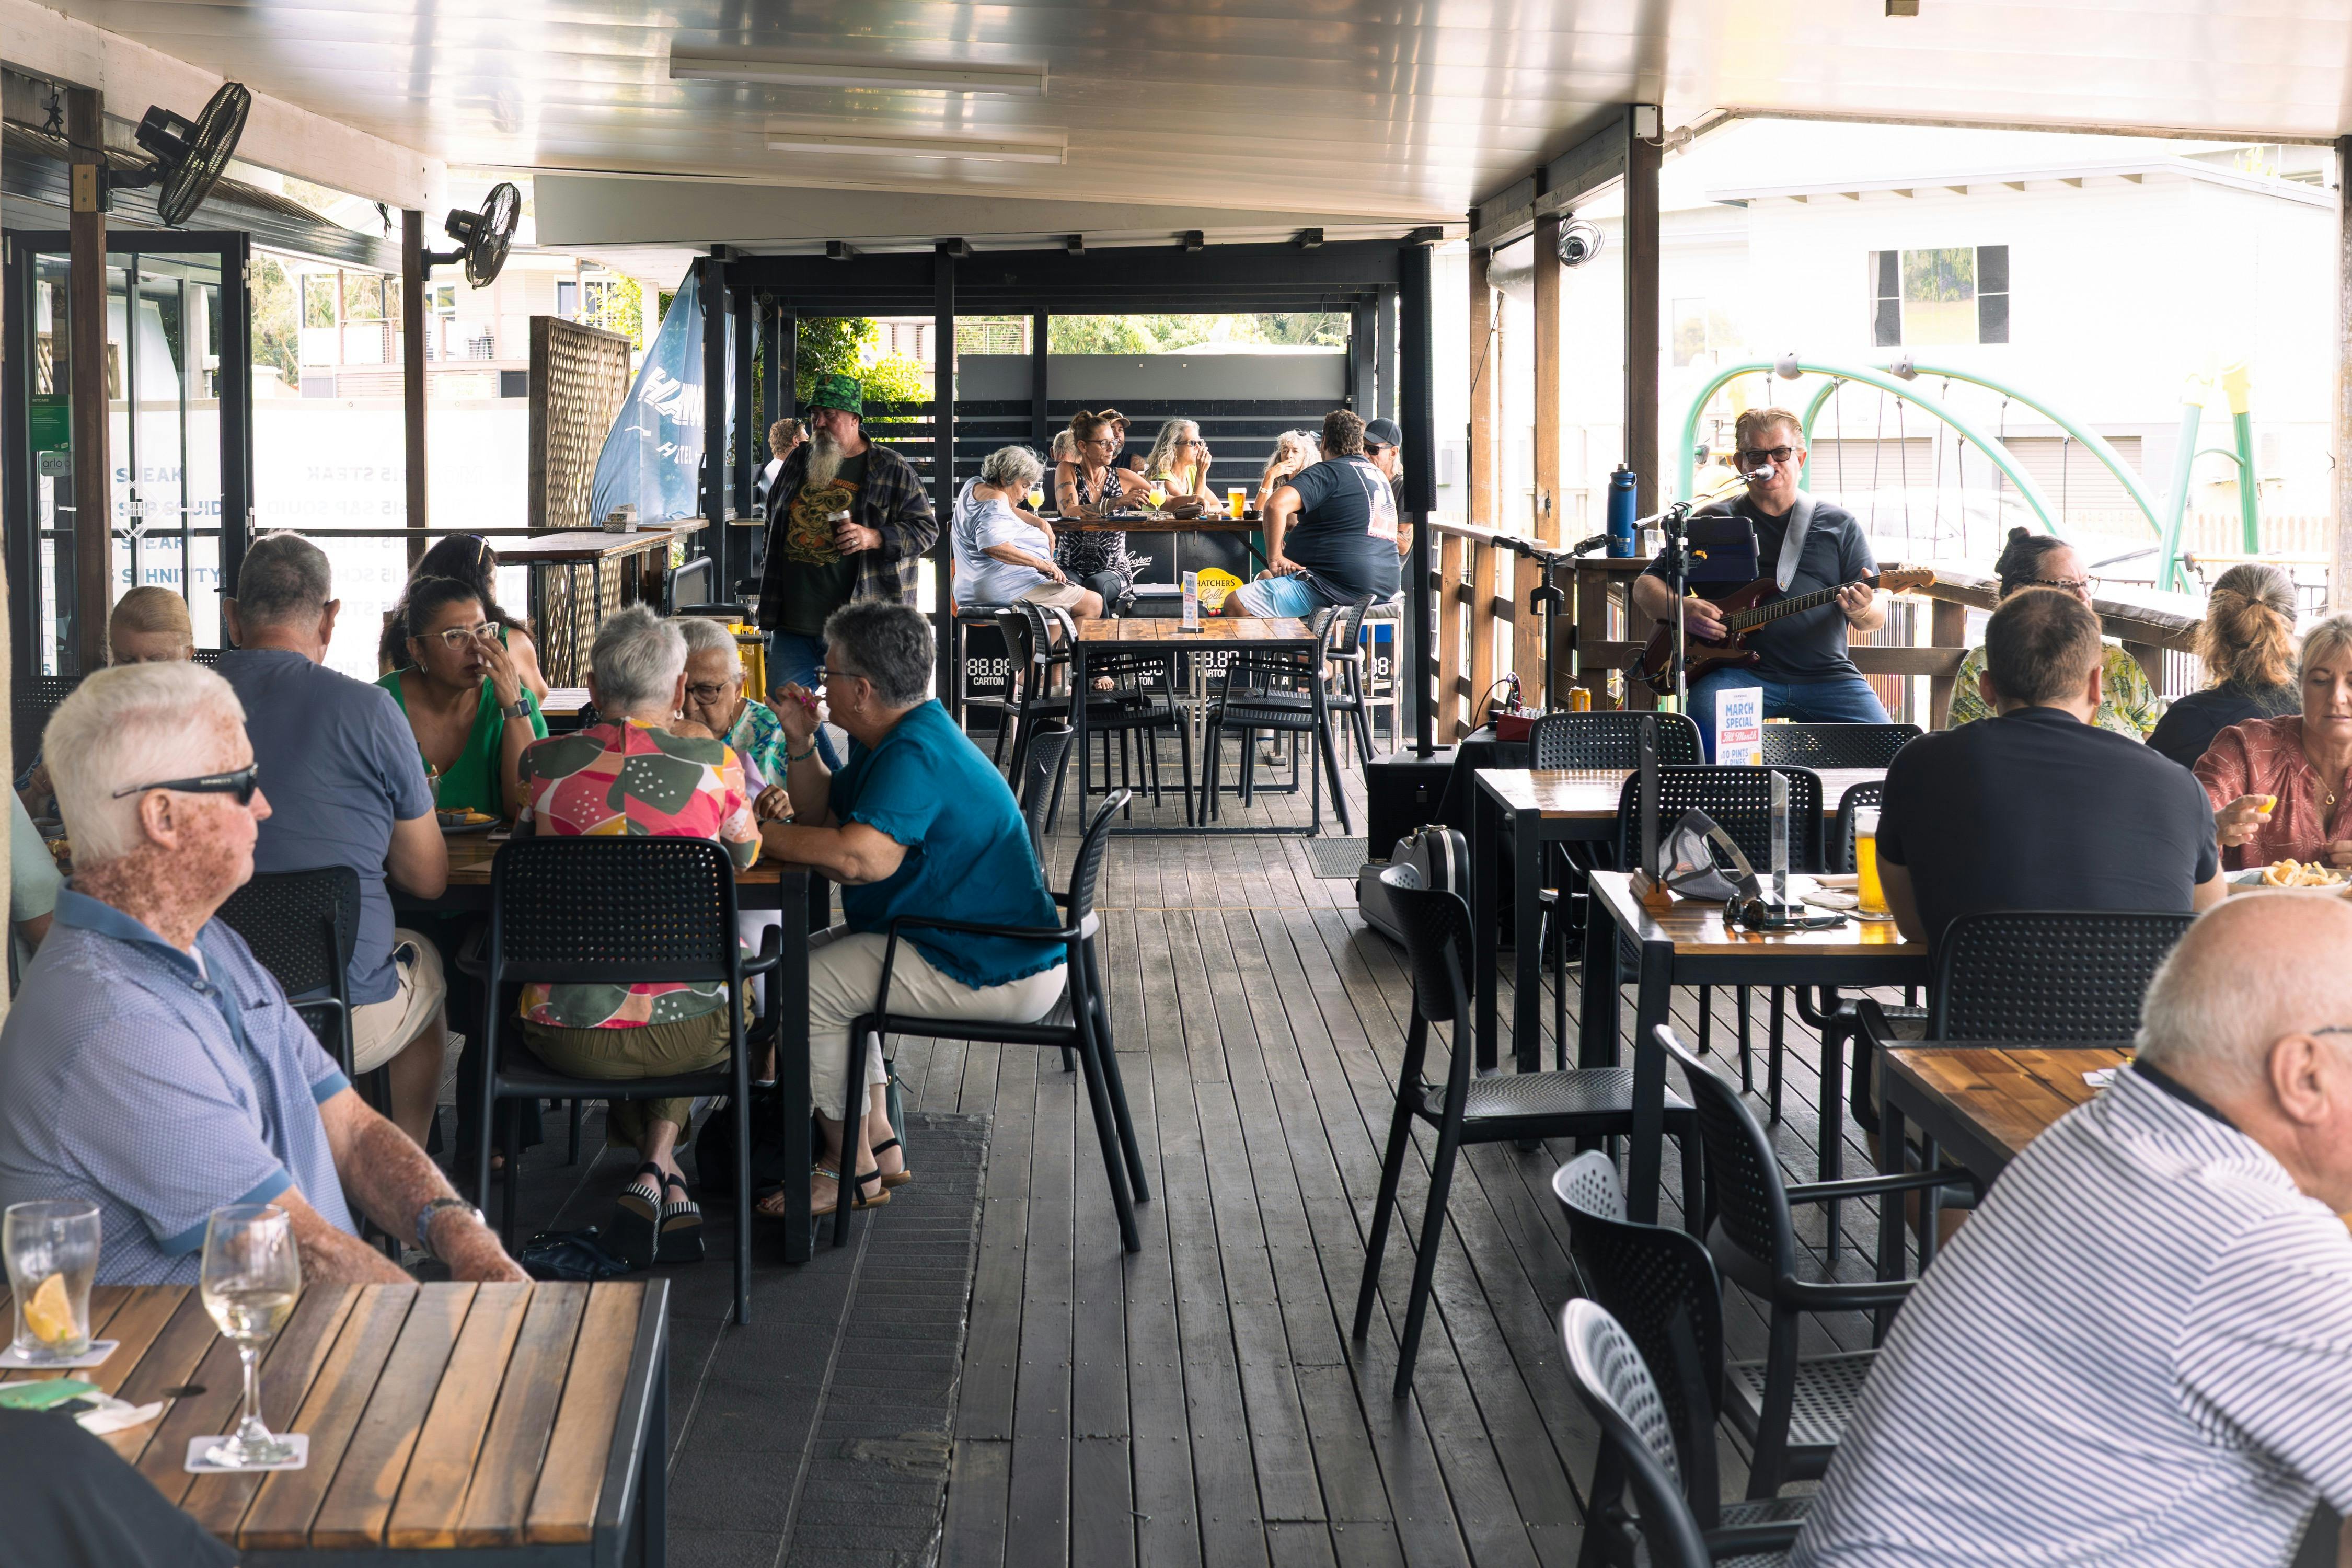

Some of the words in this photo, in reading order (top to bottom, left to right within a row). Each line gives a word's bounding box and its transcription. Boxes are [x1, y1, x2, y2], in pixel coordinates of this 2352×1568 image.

[42, 457, 63, 467] arlo
[116, 467, 181, 482] SEAK
[121, 537, 182, 549] SEAK
[1197, 579, 1235, 587] HATCHERS
[1200, 588, 1225, 604] Gold
[973, 677, 1004, 685] CARTON
[1726, 702, 1753, 716] MARCH
[1726, 717, 1753, 728] SPECIAL
[1735, 730, 1757, 741] Month
[1732, 748, 1748, 758] PINTS
